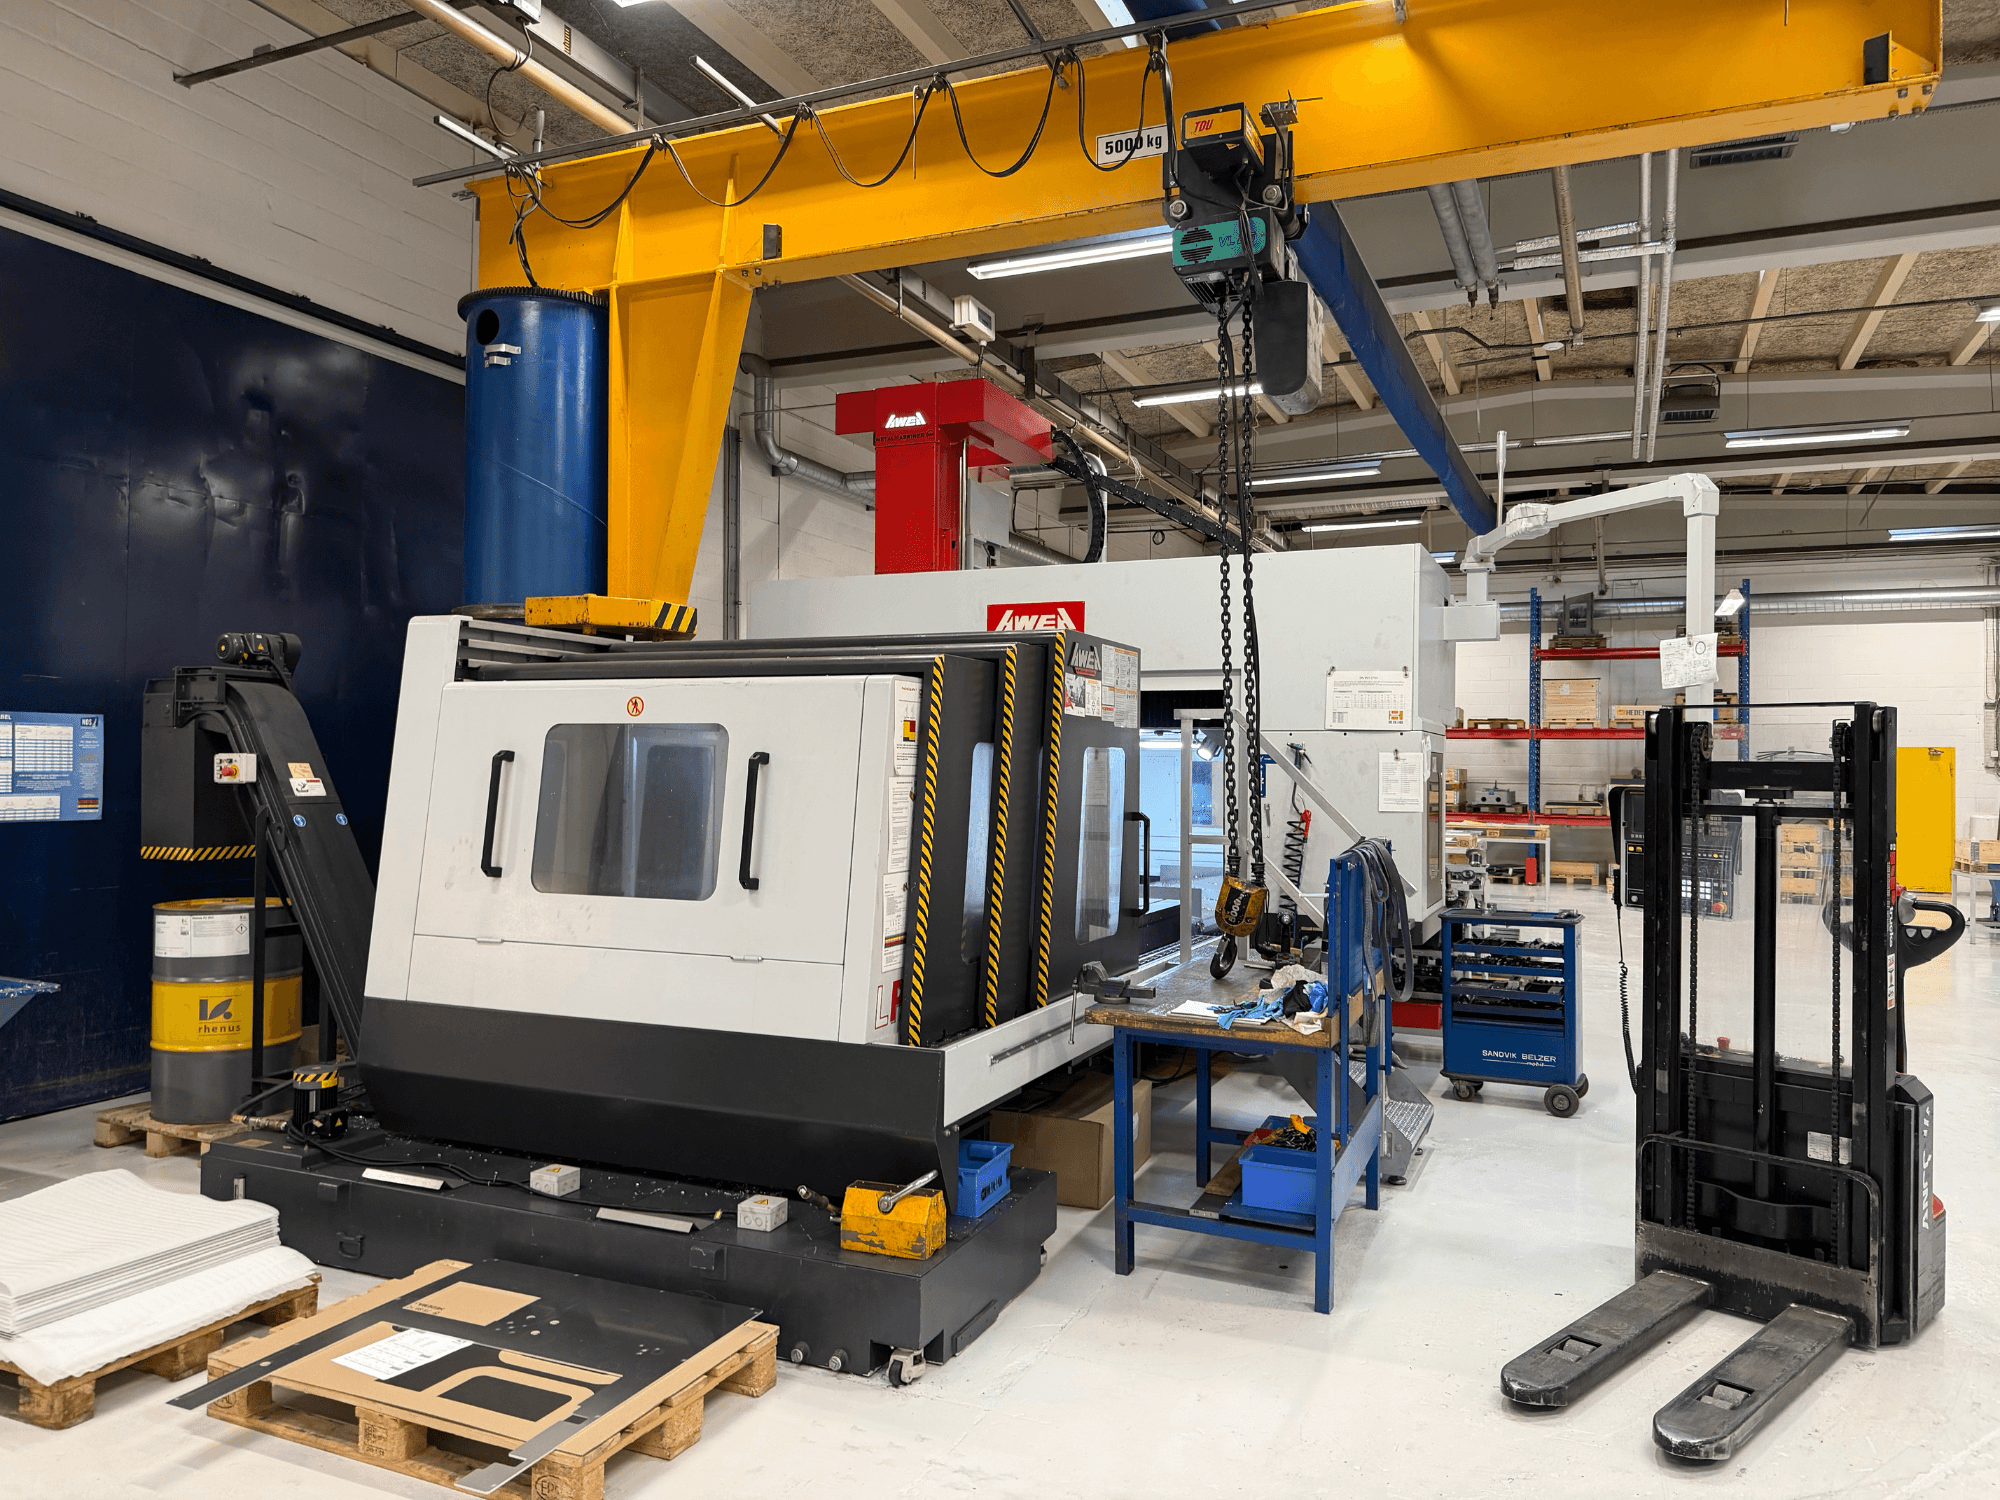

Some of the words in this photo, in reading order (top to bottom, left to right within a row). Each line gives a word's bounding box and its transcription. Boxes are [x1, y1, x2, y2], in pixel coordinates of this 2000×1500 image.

[1194, 118, 1213, 132] TDU
[1104, 136, 1143, 155] 5000
[1146, 133, 1162, 149] kg
[995, 607, 1076, 631] AWEA
[1070, 642, 1101, 671] AWEA
[198, 1023, 241, 1033] rhenus
[1482, 1049, 1517, 1059] SANDVIK
[1521, 1053, 1557, 1063] BELZER
